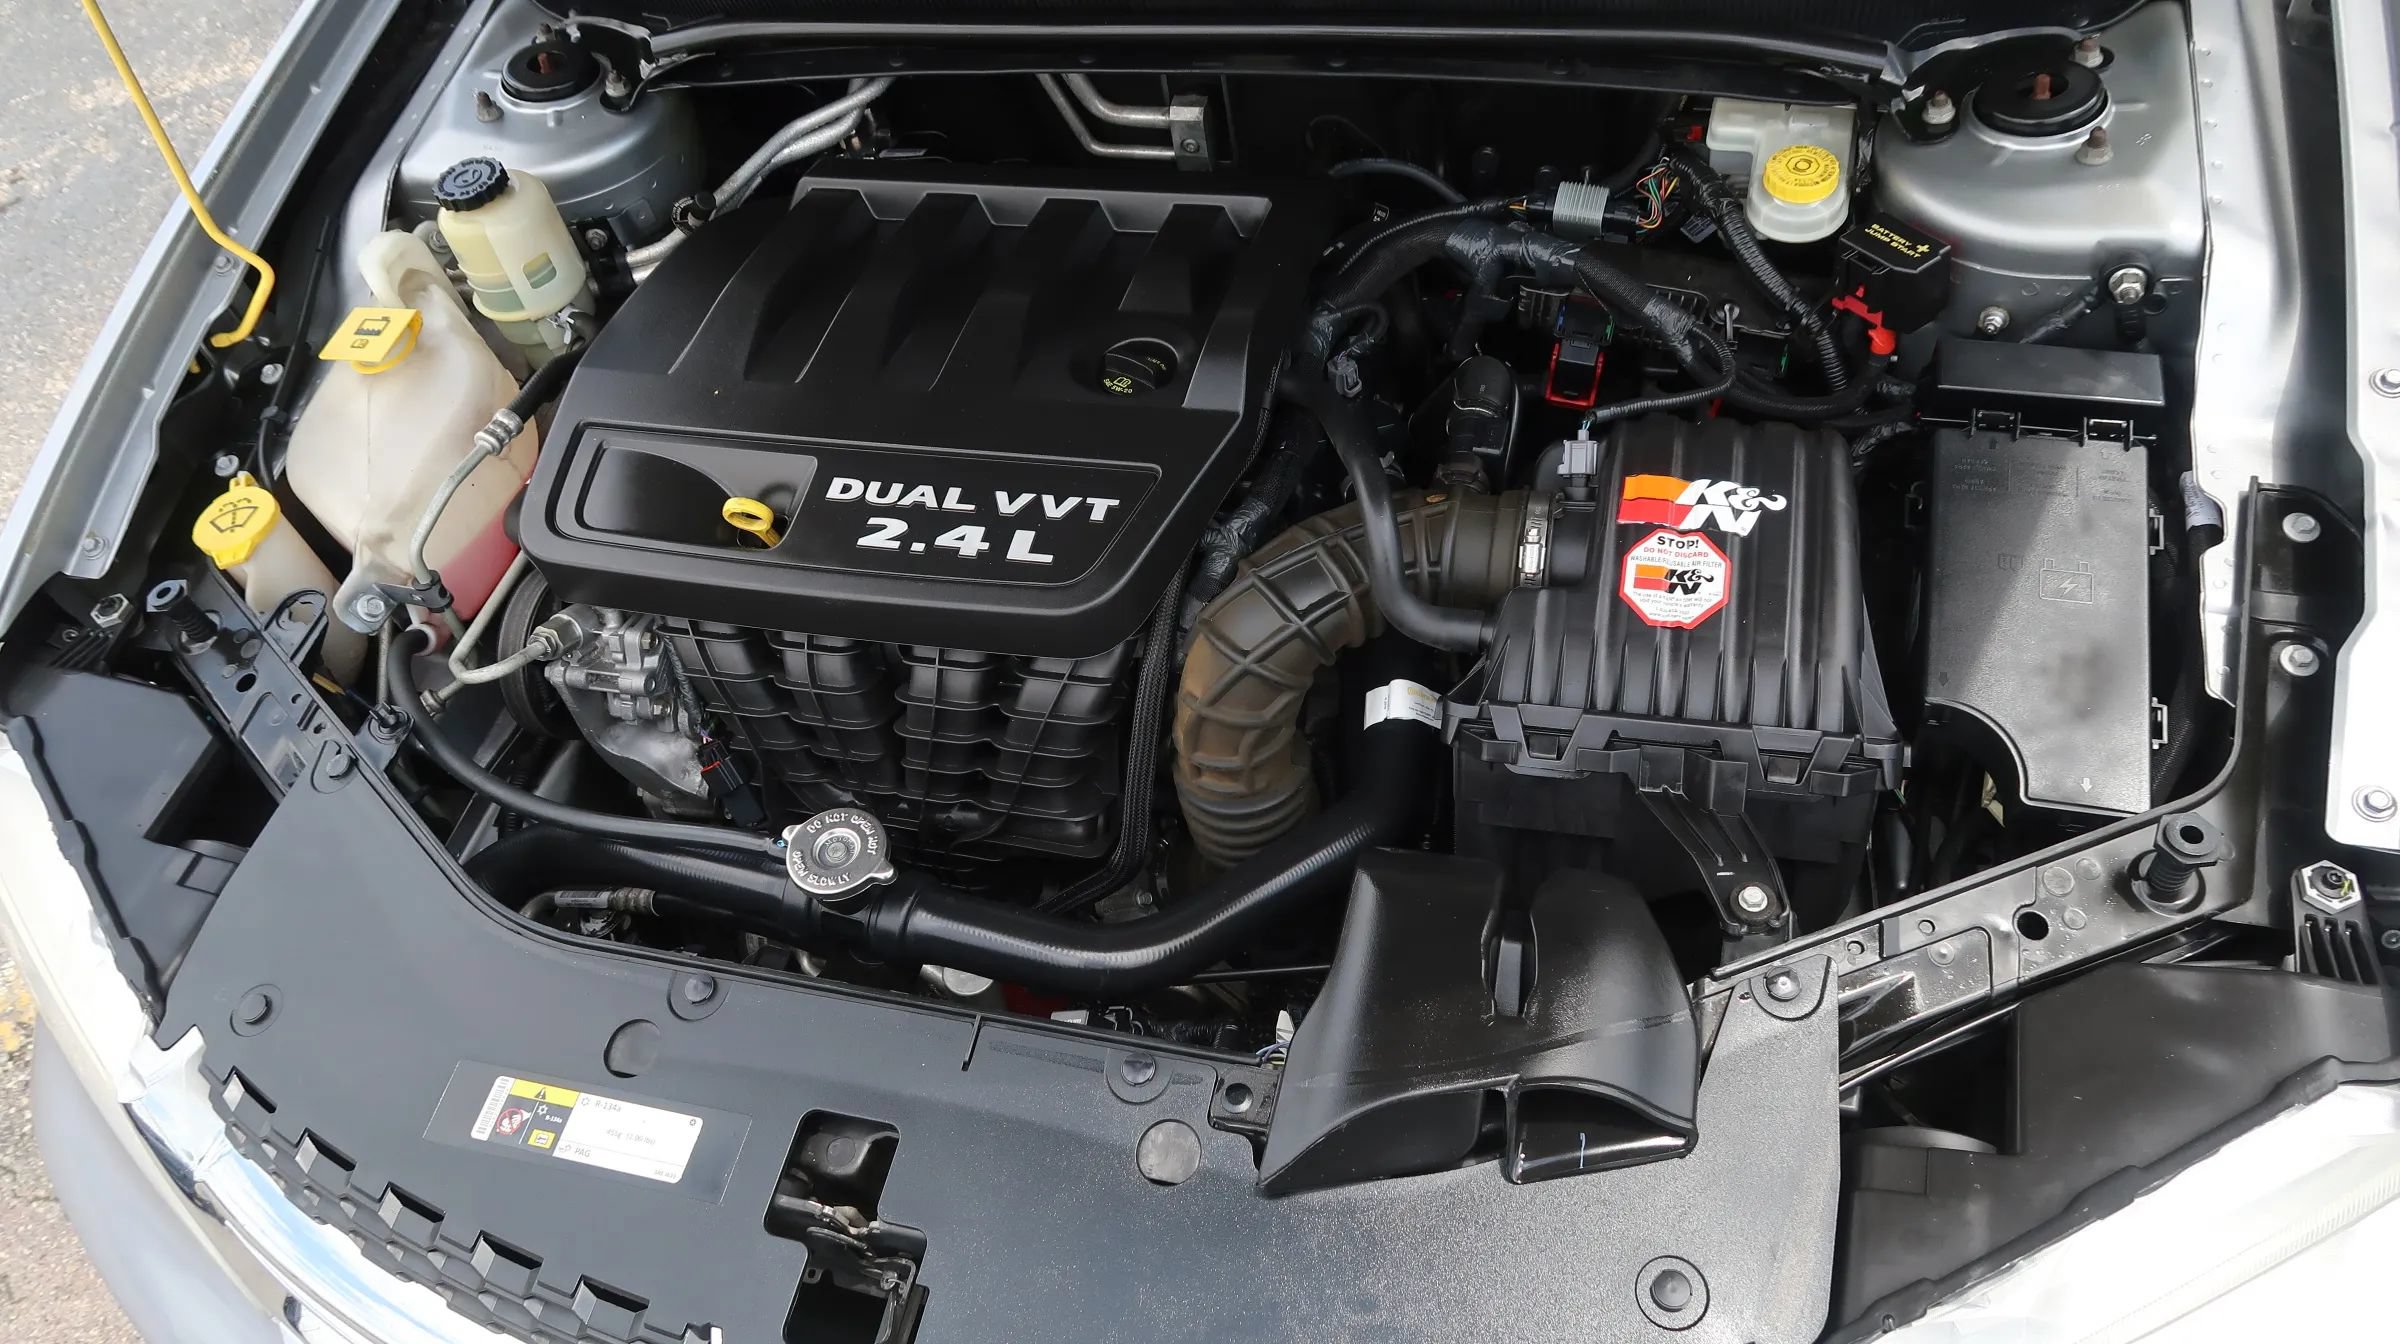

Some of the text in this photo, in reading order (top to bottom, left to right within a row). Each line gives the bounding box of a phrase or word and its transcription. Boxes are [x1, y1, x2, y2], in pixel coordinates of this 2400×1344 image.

[1864, 227, 1922, 258] JUMP START
[1870, 223, 1913, 247] BATTERY
[1111, 384, 1133, 394] 5W-20
[825, 476, 1121, 523] DUAL VVT
[1675, 478, 1788, 537] K&N
[1657, 535, 1700, 550] STOP!
[1657, 548, 1672, 556] NOT
[1674, 551, 1709, 559] DISCARD
[1702, 560, 1722, 569] FILTER
[1663, 568, 1715, 596] K&N
[806, 819, 823, 834] DO
[825, 812, 849, 824] NOT
[850, 814, 876, 836] OPEN
[792, 850, 852, 886] OPEN SLOWLY
[594, 1099, 622, 1113] R-134a
[544, 1114, 563, 1124] R-134a
[574, 1146, 591, 1158] PAG
